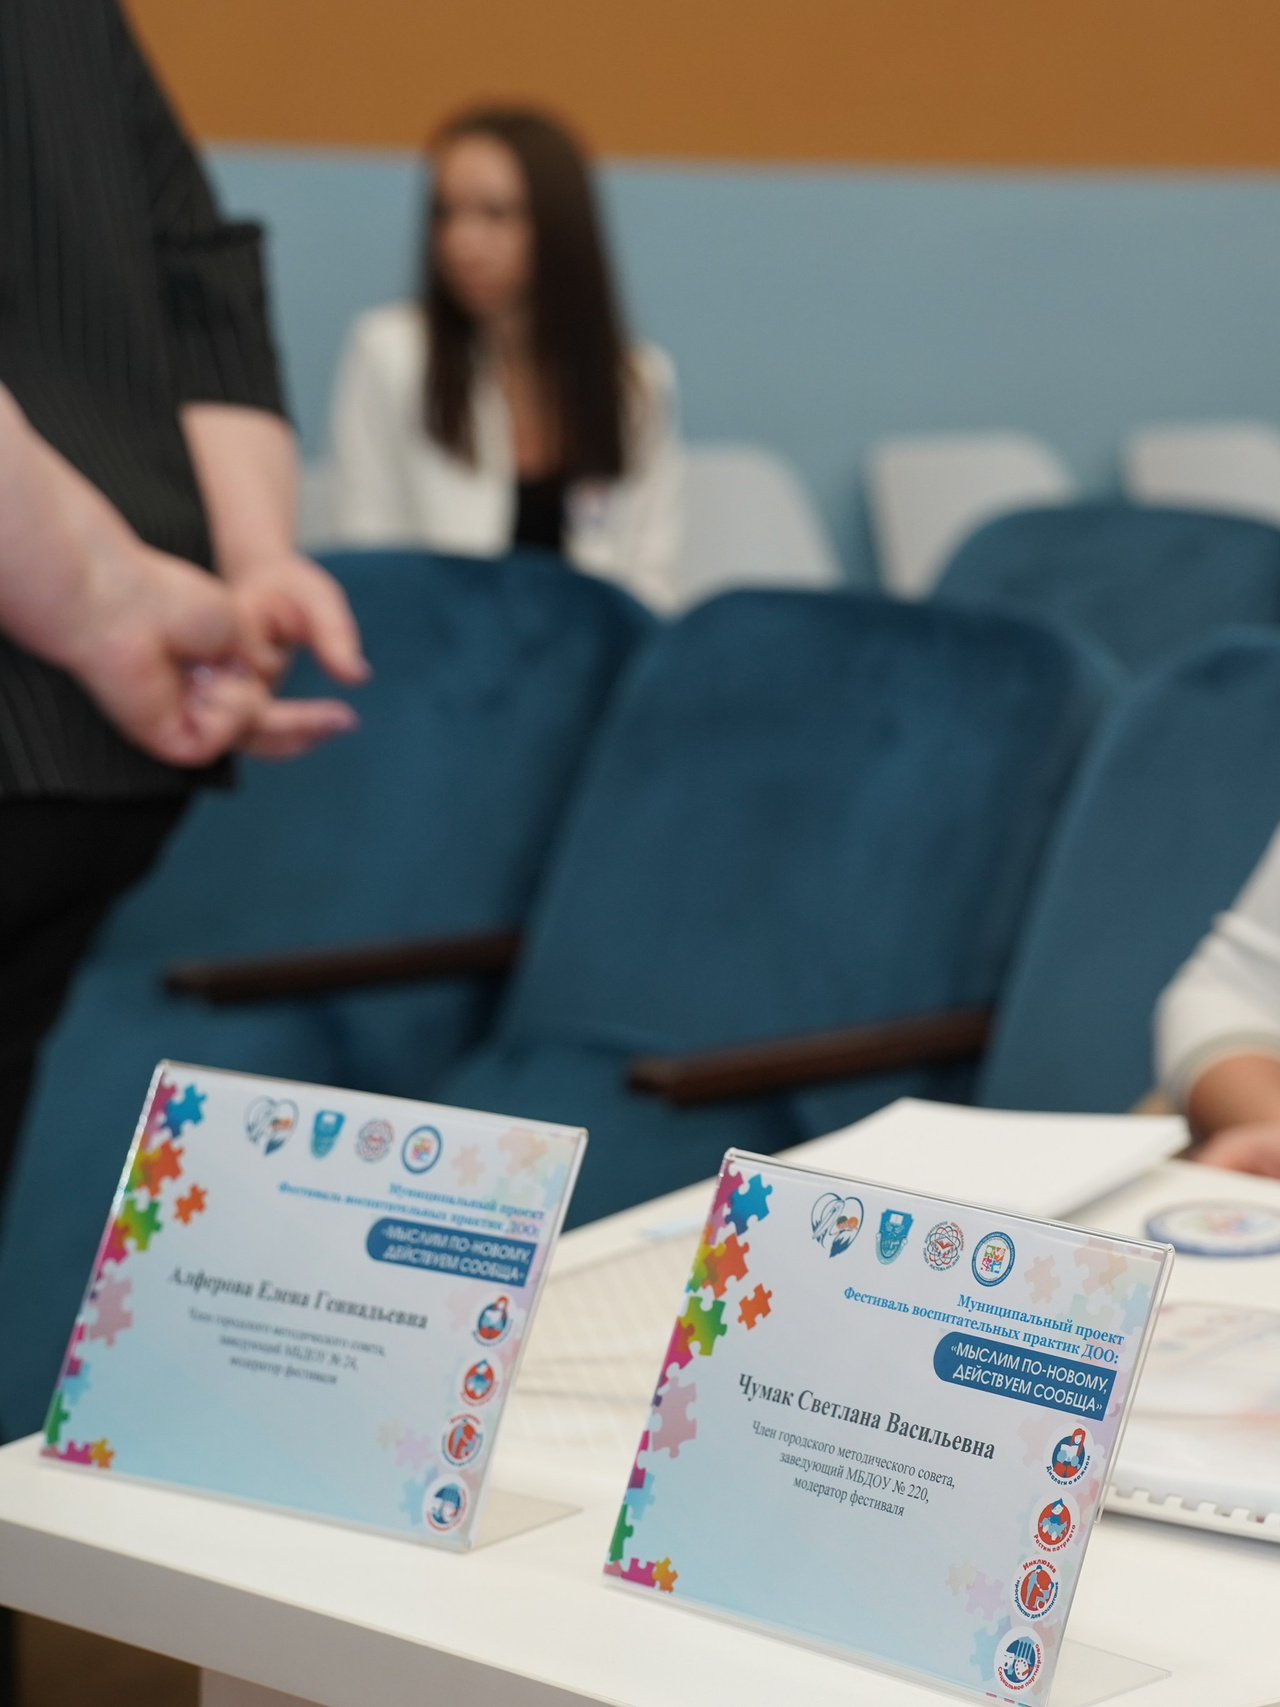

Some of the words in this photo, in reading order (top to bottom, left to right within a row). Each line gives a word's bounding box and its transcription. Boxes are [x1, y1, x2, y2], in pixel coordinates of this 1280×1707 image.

[382, 1244, 458, 1269] ДЕЙСТВУЕМ
[256, 1280, 311, 1309] Елена
[312, 1290, 429, 1330] Геннадьевна
[844, 1286, 910, 1313] Фестиваль
[912, 1304, 1020, 1341] воспитательных
[1022, 1330, 1080, 1355] практик
[1081, 1343, 1119, 1365] ДОО:
[957, 1294, 1073, 1334] Муниципальный
[1075, 1321, 1125, 1346] проект
[950, 1341, 1021, 1370] «МЫСЛИМ
[1022, 1358, 1108, 1395] ПО-НОВОМУ,
[952, 1363, 1032, 1396] ДЕЙСТВУЕМ
[1033, 1383, 1103, 1412] СООБЩА»
[738, 1372, 794, 1407] Чумак
[797, 1389, 882, 1429] Светлана
[885, 1412, 996, 1459] Васильевна
[751, 1420, 777, 1439] Член
[778, 1430, 836, 1454] городского
[838, 1445, 916, 1476] методического
[918, 1467, 956, 1490] совета,
[779, 1452, 844, 1479] заведующий
[846, 1466, 891, 1491] МБДОУ
[892, 1481, 906, 1495] №
[907, 1484, 930, 1504] 220,
[793, 1476, 848, 1504] модератор
[849, 1490, 905, 1517] фестиваля
